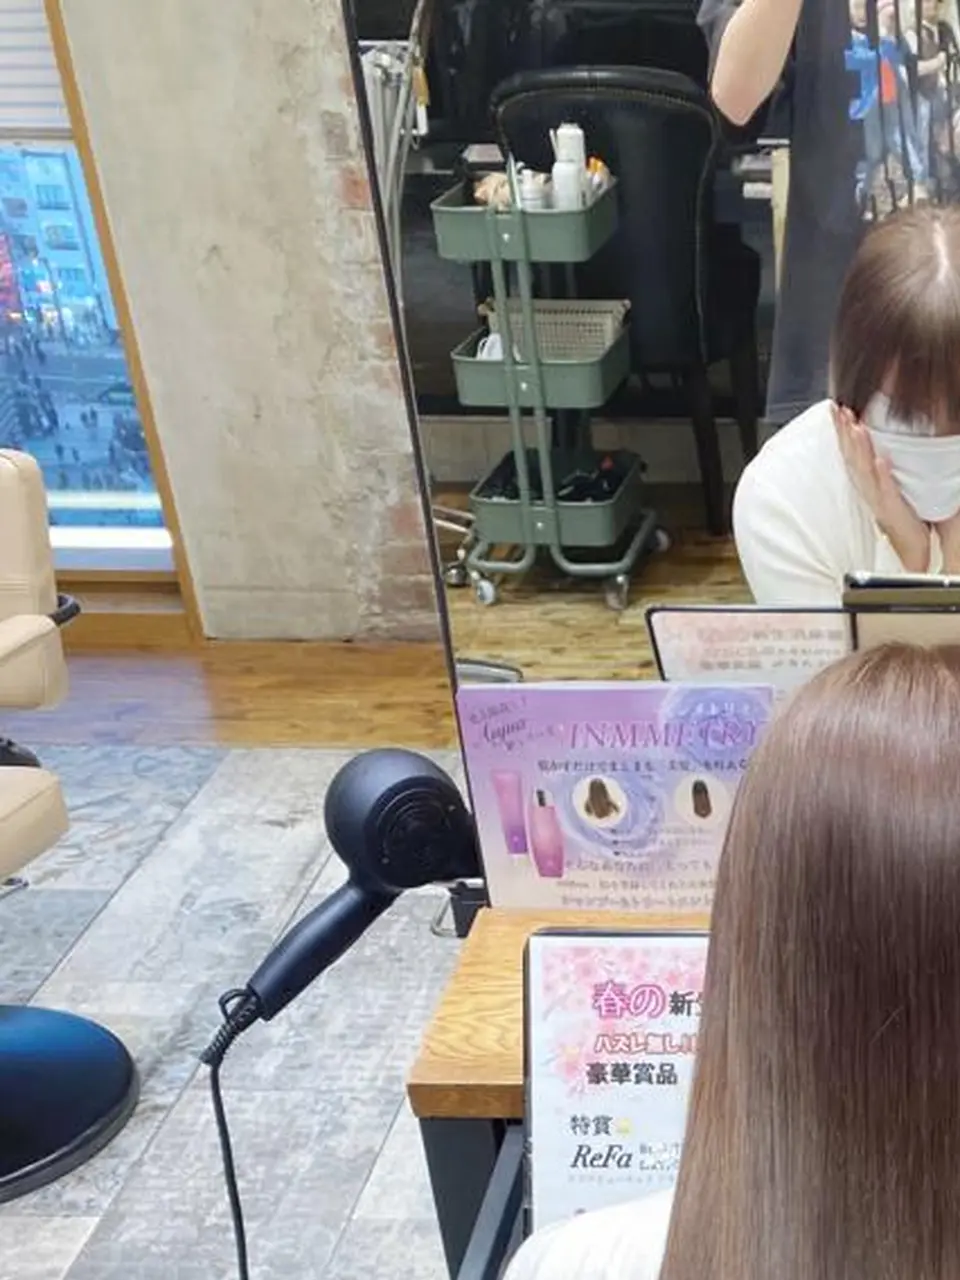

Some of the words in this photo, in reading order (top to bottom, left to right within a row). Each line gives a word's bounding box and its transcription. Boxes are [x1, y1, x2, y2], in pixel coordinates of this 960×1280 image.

[586, 1062, 678, 1085] 豪華賞品
[570, 1114, 613, 1137] 特賞
[570, 1144, 633, 1168] ReFa
